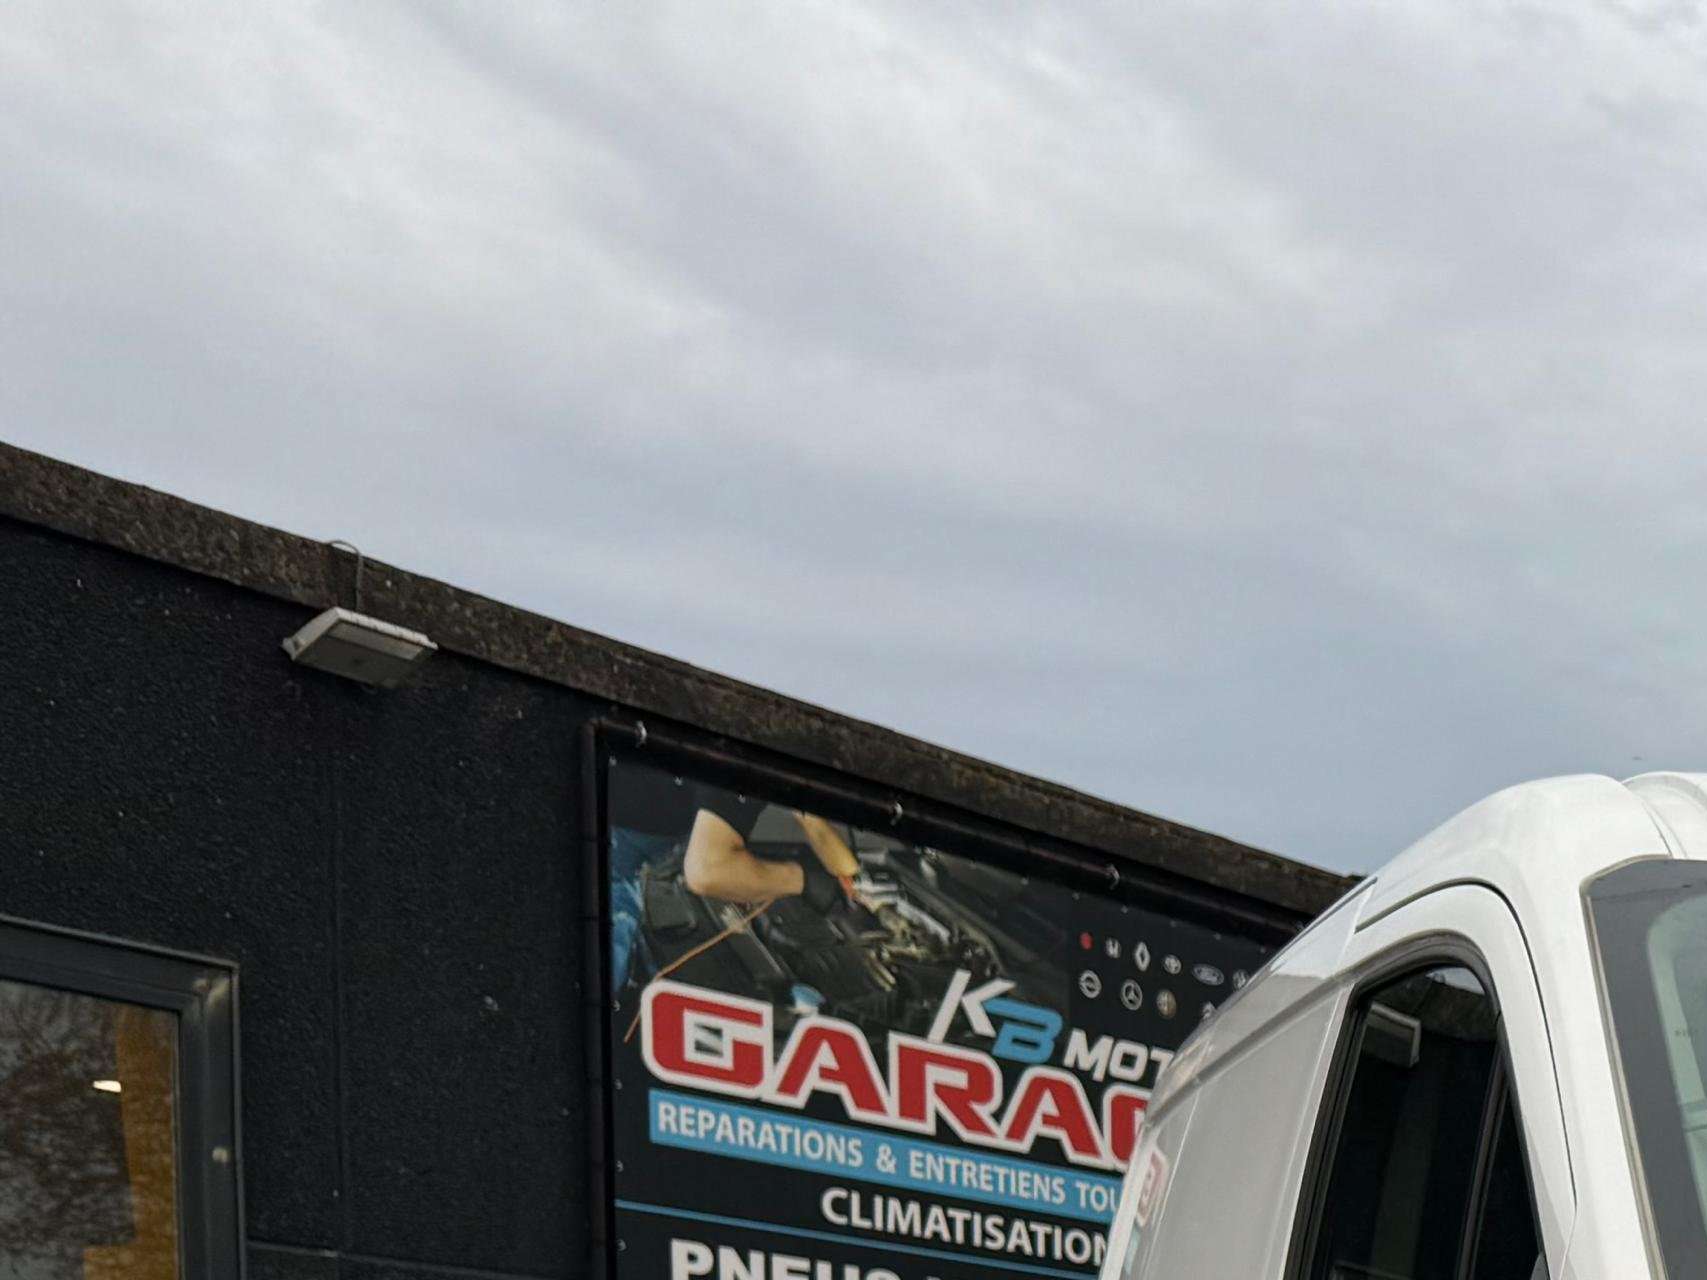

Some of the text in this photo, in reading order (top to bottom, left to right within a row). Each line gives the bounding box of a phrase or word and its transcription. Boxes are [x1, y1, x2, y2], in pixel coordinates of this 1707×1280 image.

[928, 969, 1064, 1065] KB
[657, 1100, 864, 1169] REPARATIONS
[875, 1142, 898, 1175] &
[908, 1149, 1067, 1205] ENTRETIENS
